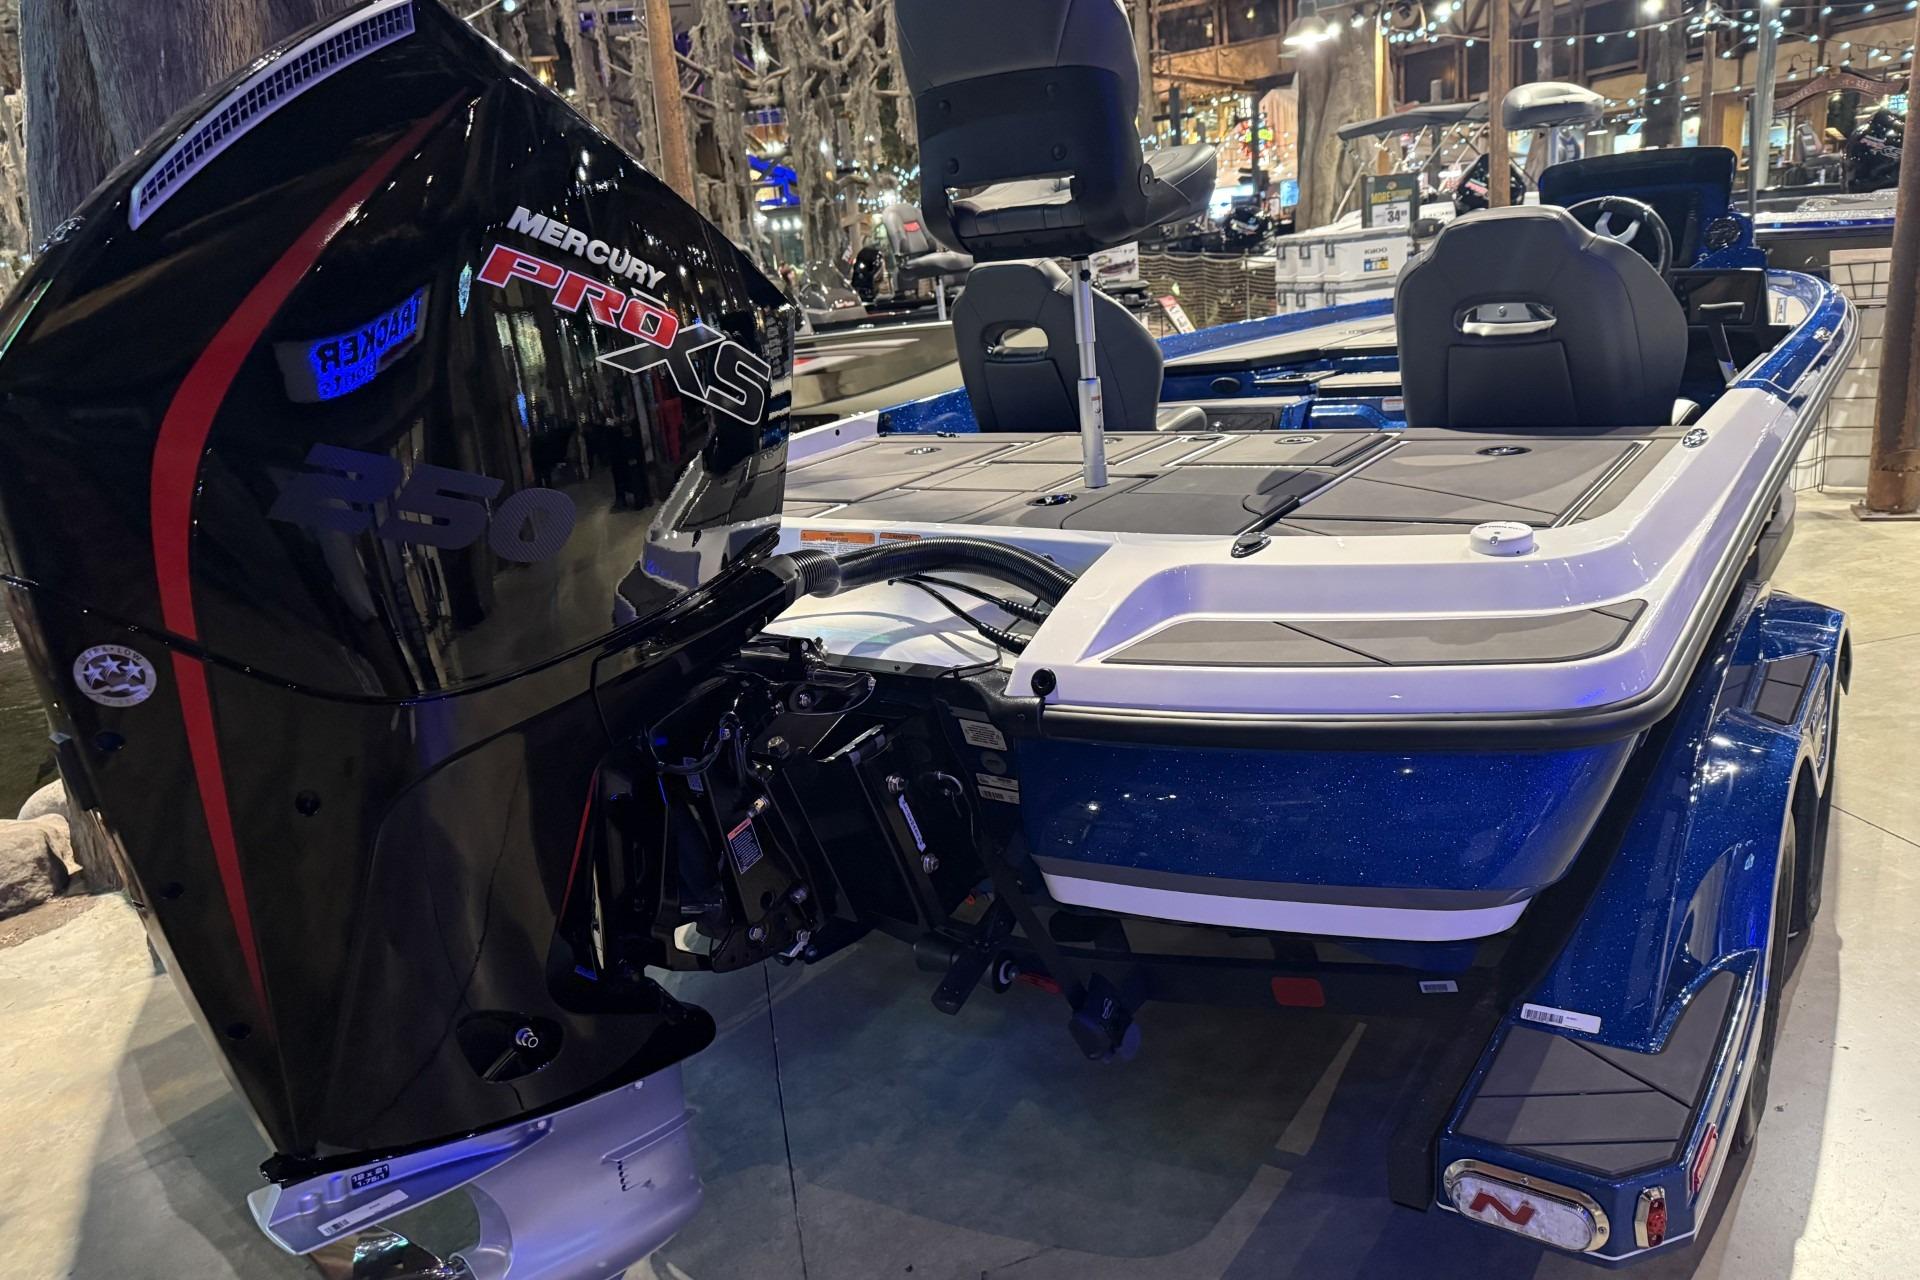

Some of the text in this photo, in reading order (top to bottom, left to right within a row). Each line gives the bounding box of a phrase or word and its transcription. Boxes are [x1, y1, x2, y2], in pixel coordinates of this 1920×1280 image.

[477, 244, 679, 349] PRO
[506, 205, 666, 289] MERCURY
[265, 442, 576, 562] 250
